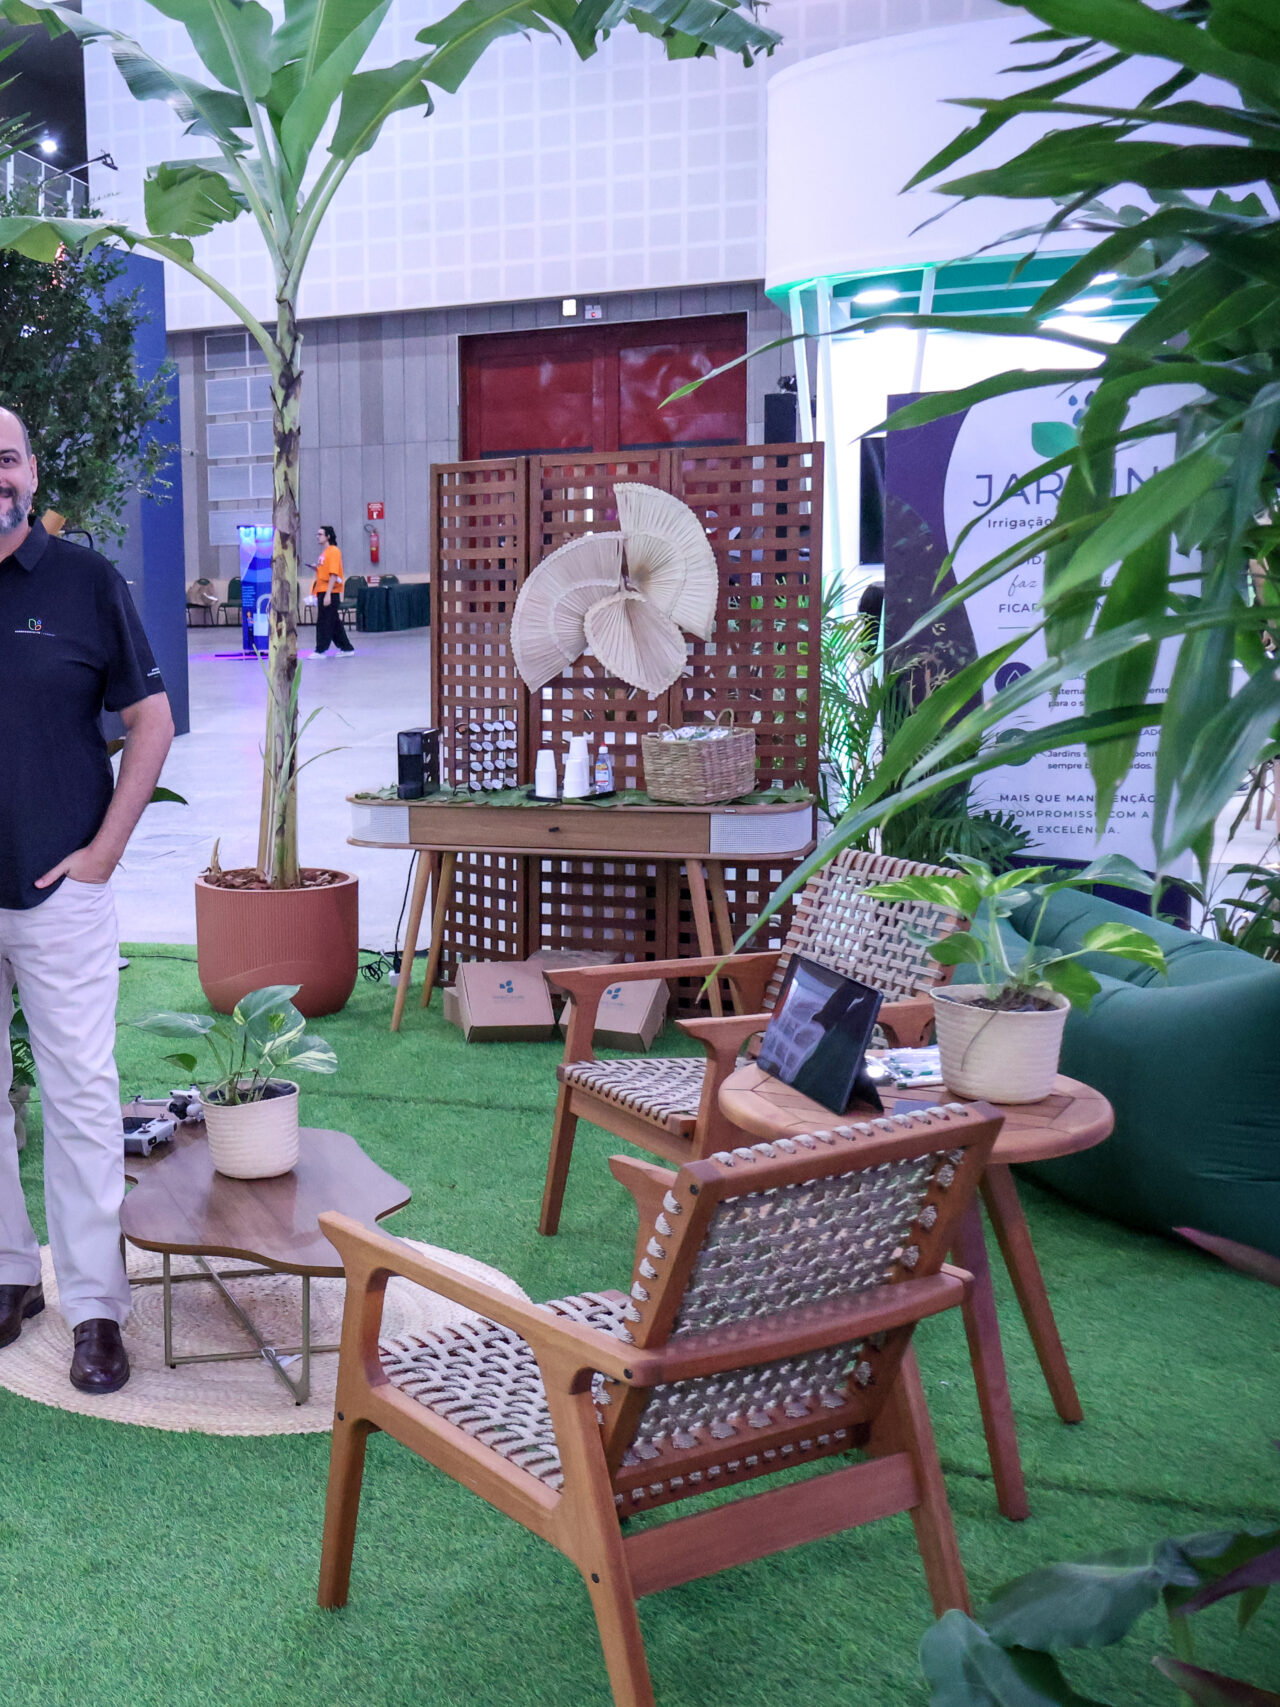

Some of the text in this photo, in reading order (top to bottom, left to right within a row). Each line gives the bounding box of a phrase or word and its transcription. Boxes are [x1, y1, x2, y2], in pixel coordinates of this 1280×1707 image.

[1048, 763, 1082, 771] sempre
[1000, 793, 1156, 804] MAIS QUE MANENÇÃO
[1008, 810, 1097, 818] OMPROMISS
[1109, 810, 1136, 819] COM
